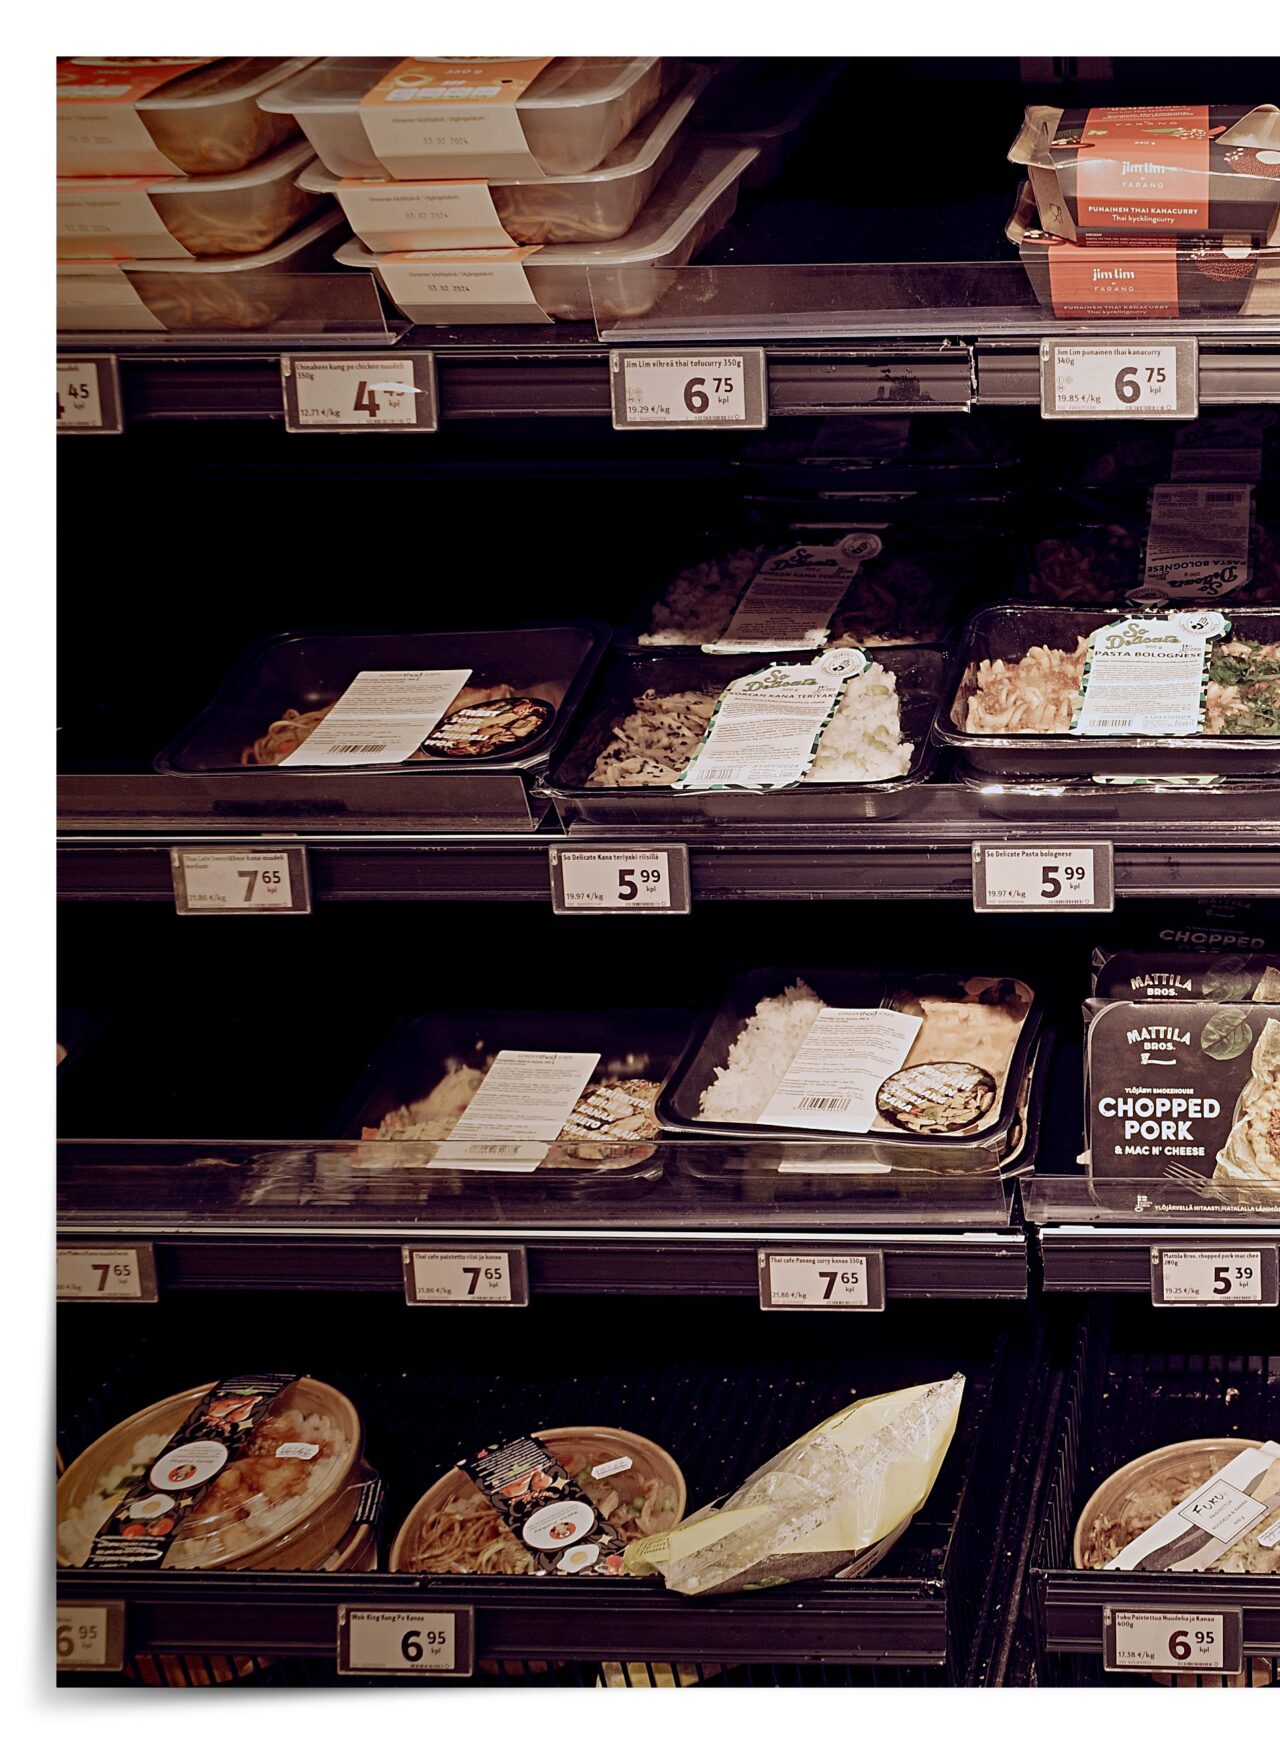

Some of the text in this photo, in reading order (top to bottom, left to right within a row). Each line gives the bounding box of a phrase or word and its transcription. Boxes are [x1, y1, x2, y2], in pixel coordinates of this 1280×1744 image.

[1088, 206, 1198, 215] PUNAINEN THAI KANACURRY
[1112, 214, 1175, 224] Thai kycklingcurry
[1093, 268, 1135, 281] jim lim
[1082, 349, 1111, 357] punainen
[1129, 349, 1161, 357] kanacurry
[626, 360, 637, 368] Jim
[639, 360, 650, 368] Lim
[690, 360, 722, 368] tofucurry
[68, 384, 89, 398] 45
[1115, 367, 1166, 404] 6 75
[684, 377, 733, 414] 6 75
[1197, 582, 1223, 595] So
[1123, 623, 1149, 637] So
[1105, 635, 1181, 650] Delicate
[765, 669, 790, 683] So
[742, 678, 818, 692] Delicate
[613, 854, 637, 862] teriyaki
[1040, 850, 1072, 858] bolognese
[237, 870, 281, 902] 7 65
[618, 869, 660, 900] 5 99
[1041, 866, 1085, 898] 5 99
[1159, 929, 1265, 950] CHOPPED
[1130, 973, 1192, 991] MATTILA
[1147, 988, 1178, 996] BROS.
[1127, 1026, 1191, 1045] MATTILA
[1144, 1042, 1176, 1050] BROS.
[1125, 1087, 1151, 1095] YLÖJÄRVI
[1098, 1098, 1221, 1118] CHOPPED
[1124, 1120, 1194, 1141] PORK
[1114, 1145, 1205, 1156] & MAC N' CHEESE
[91, 1264, 131, 1291] 7 65
[462, 1268, 502, 1295] 7 65
[819, 1272, 858, 1299] 7 65
[1213, 1267, 1252, 1297] 5 39
[57, 1626, 97, 1657] 6 95
[401, 1630, 446, 1662] 6 95
[1168, 1630, 1214, 1660] 6 95
